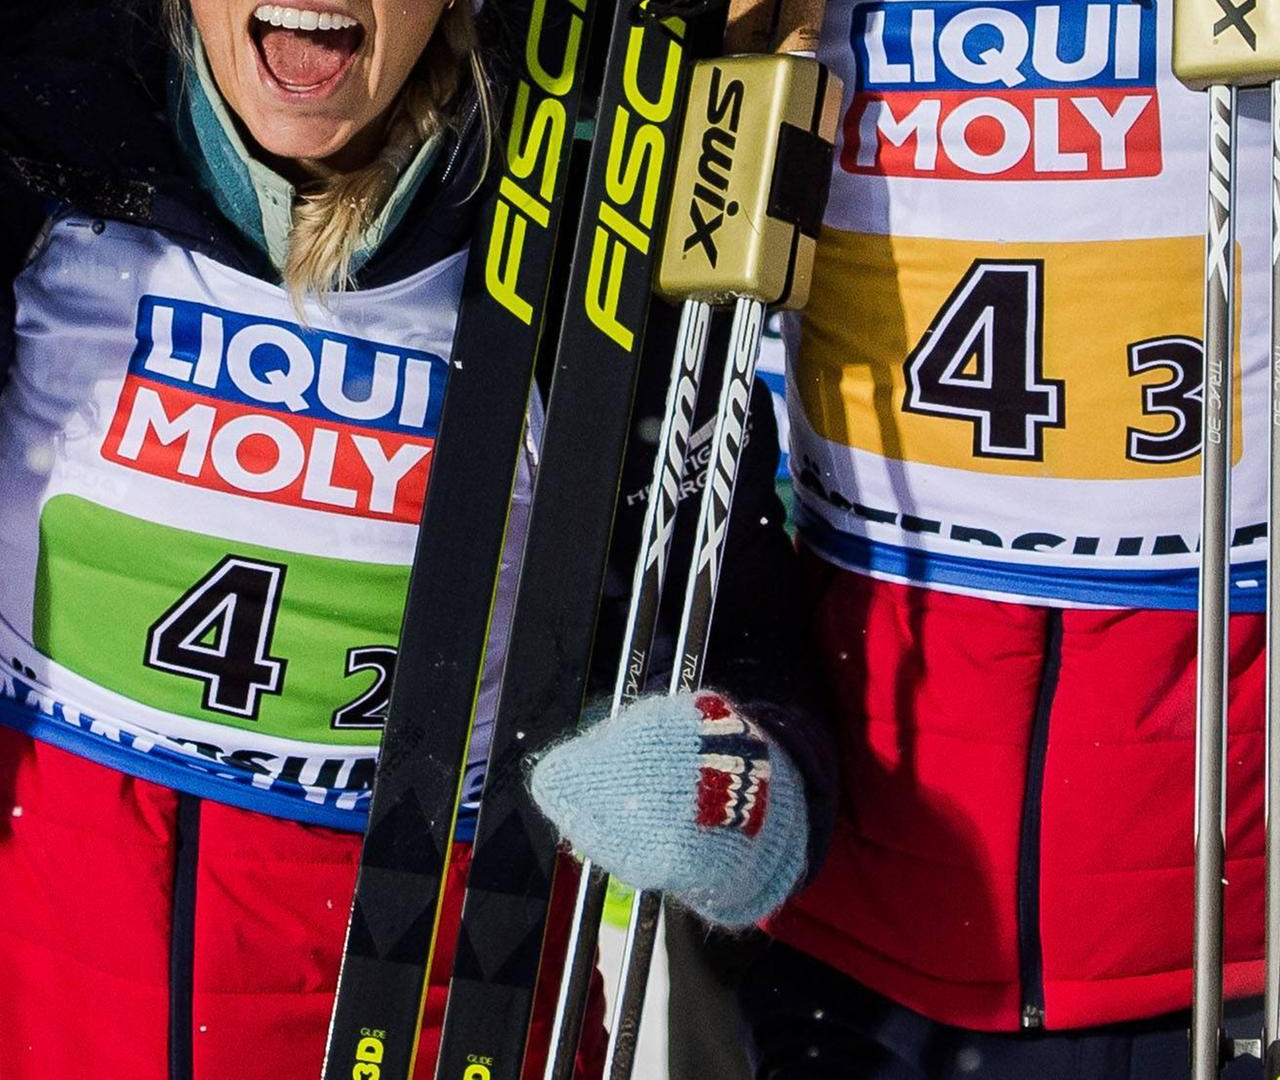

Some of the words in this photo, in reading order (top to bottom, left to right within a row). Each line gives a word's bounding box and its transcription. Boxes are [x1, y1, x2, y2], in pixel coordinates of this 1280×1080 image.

[864, 2, 1143, 87] LIQUI
[856, 92, 1154, 175] MOLY
[143, 304, 433, 428] LIQUI
[903, 258, 1066, 461] 4
[1127, 334, 1206, 464] 3
[117, 389, 433, 515] MOLY
[144, 554, 288, 721] 4
[333, 646, 396, 730] 2
